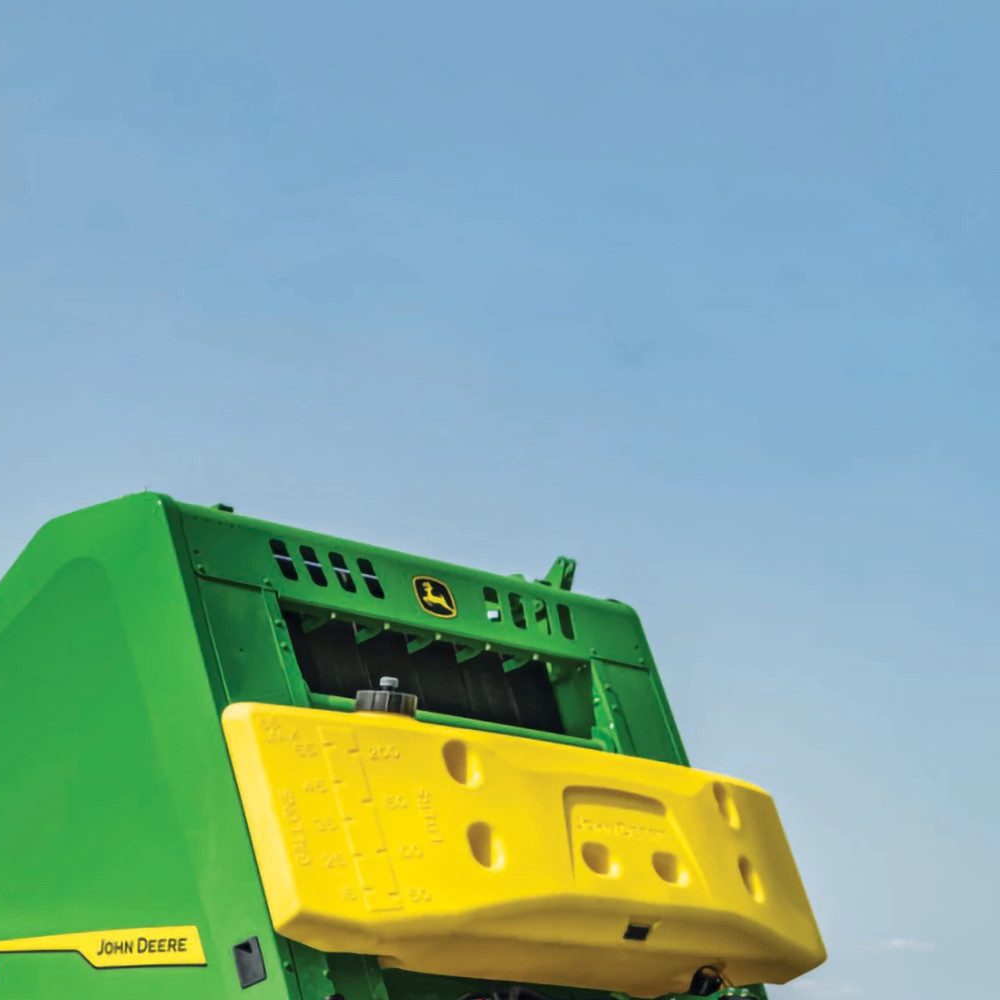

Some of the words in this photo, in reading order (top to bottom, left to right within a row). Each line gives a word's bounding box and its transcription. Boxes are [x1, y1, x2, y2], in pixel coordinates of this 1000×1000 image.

[367, 746, 401, 761] 200
[97, 938, 133, 956] JOHN
[137, 937, 188, 953] DEERE
